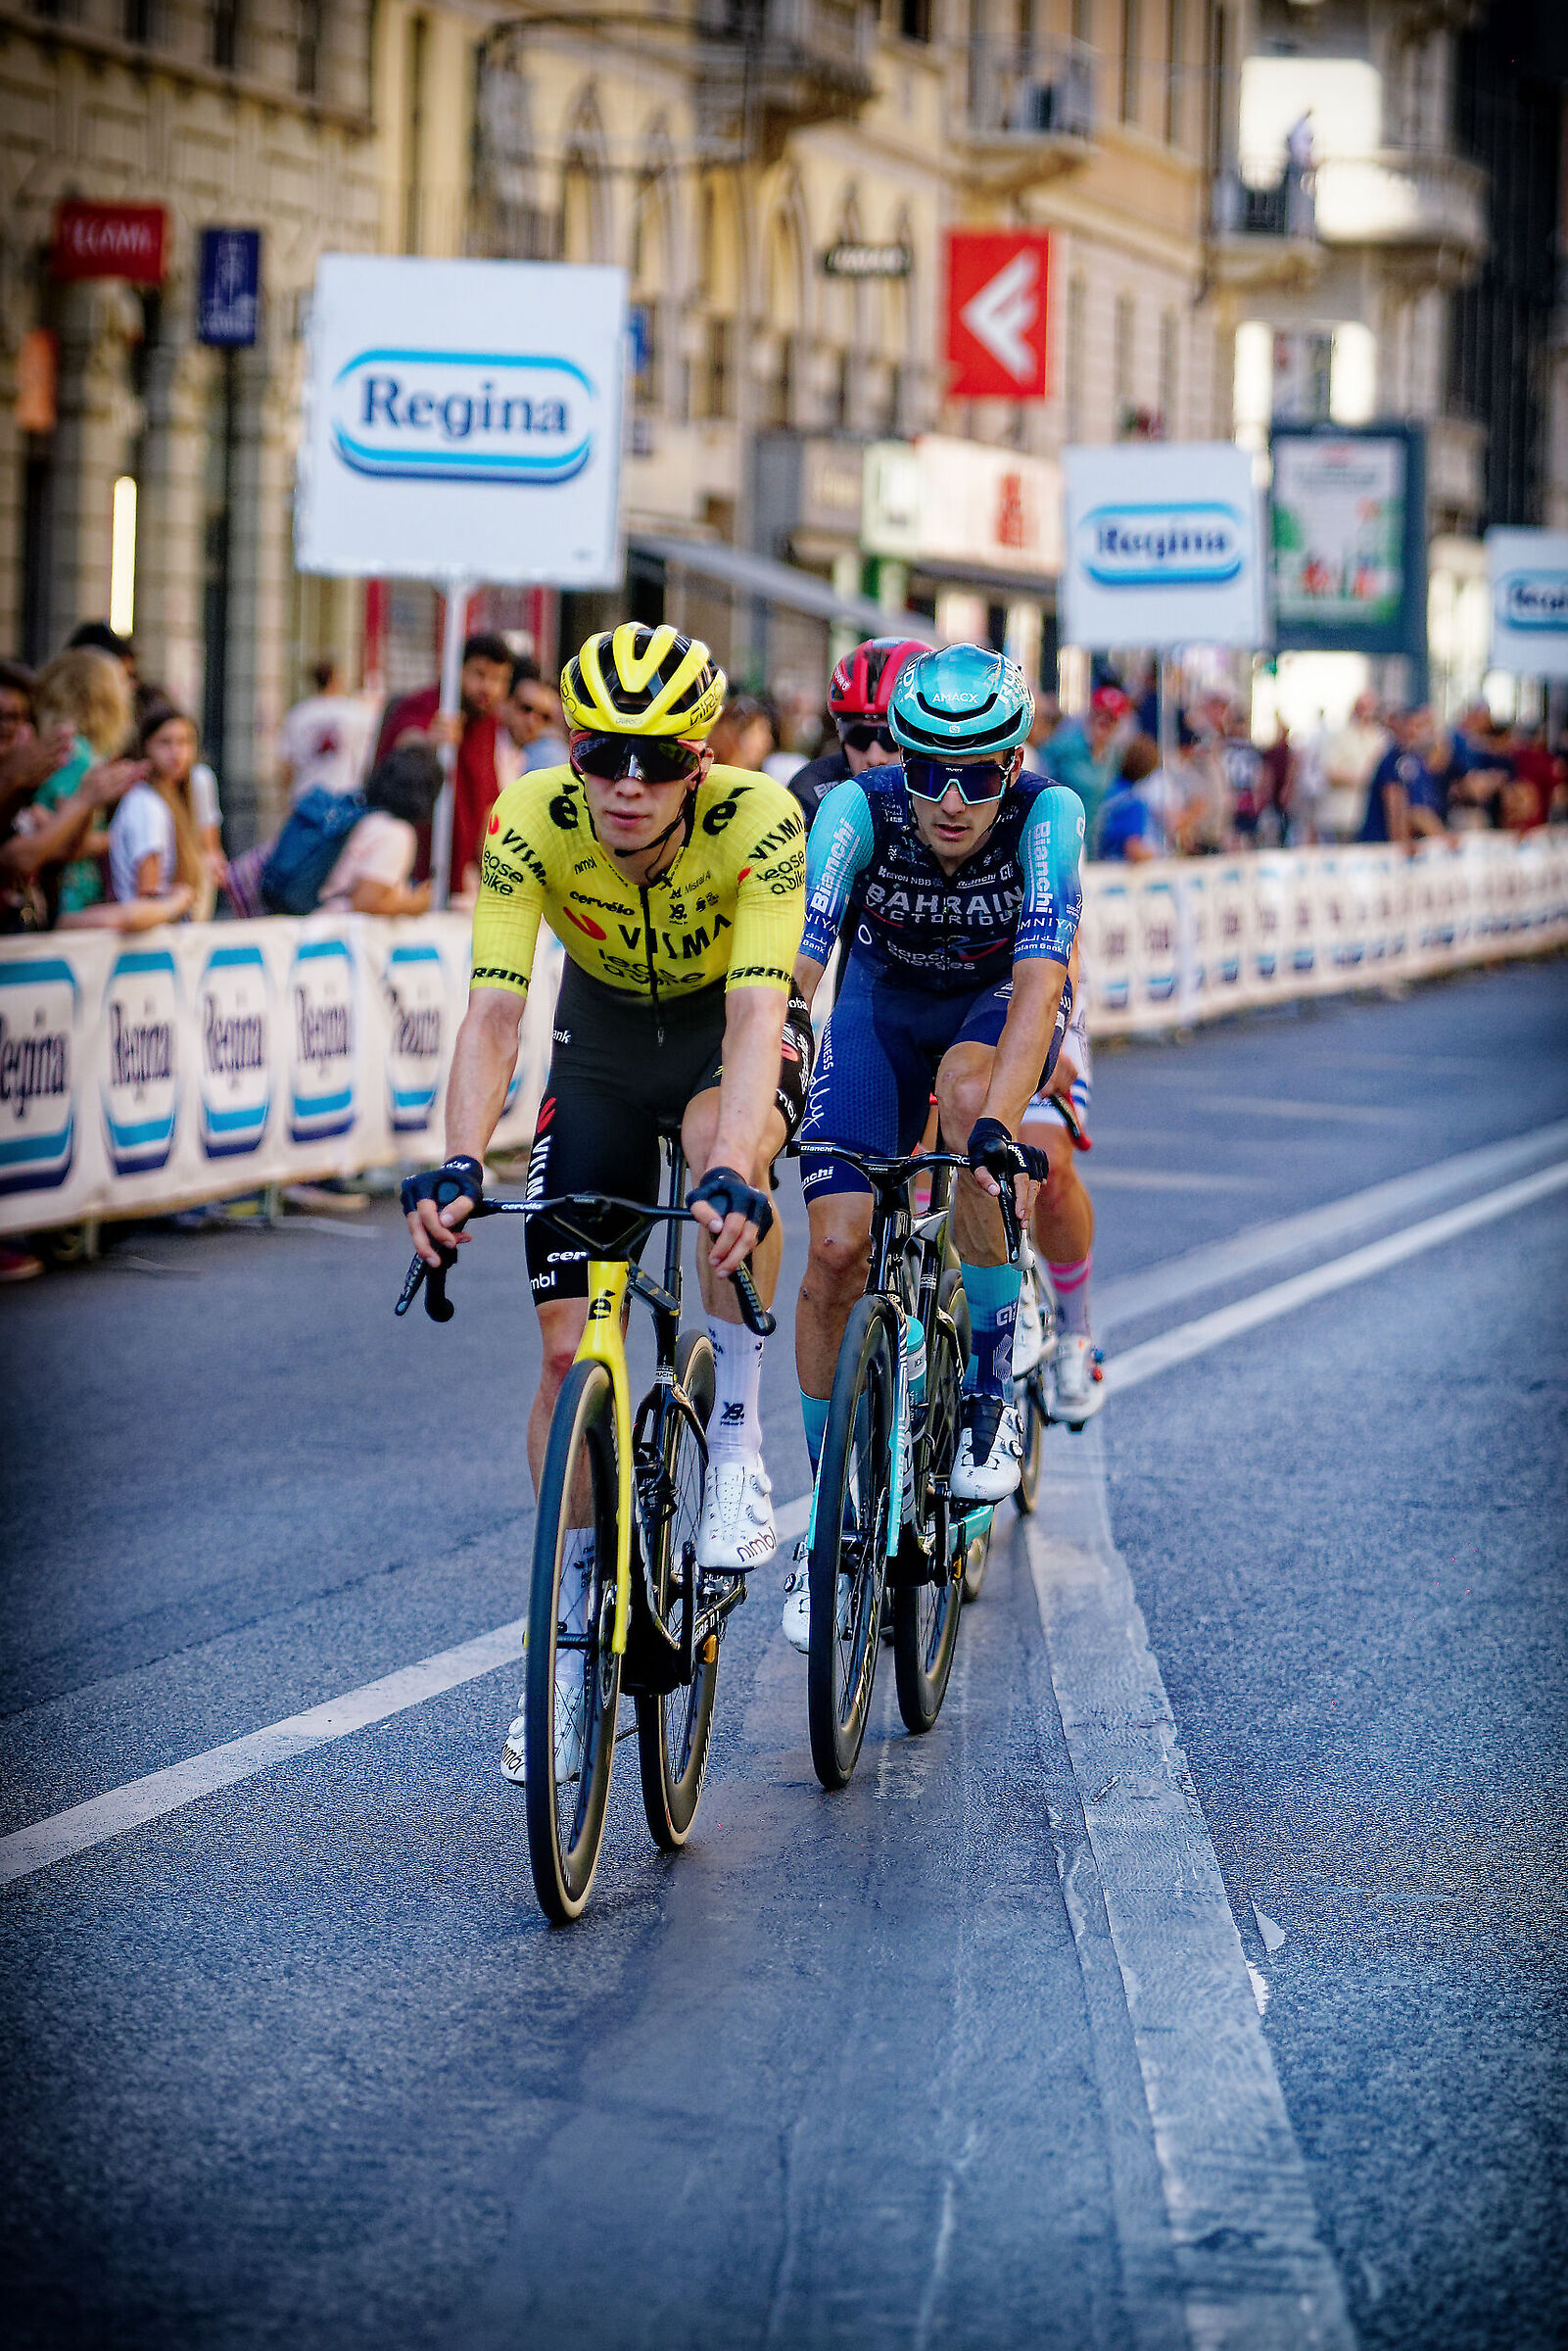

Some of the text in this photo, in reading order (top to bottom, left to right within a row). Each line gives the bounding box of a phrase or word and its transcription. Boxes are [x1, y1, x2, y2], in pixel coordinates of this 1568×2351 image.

[363, 376, 568, 439] Regina
[1097, 525, 1226, 559] Regina
[932, 692, 978, 704] AMACX
[483, 848, 524, 884] ease
[811, 817, 856, 913] Bianchi
[1034, 821, 1053, 913] Bianchi
[569, 890, 635, 916] cervélo
[867, 883, 1024, 915] BAHRAIN
[618, 913, 733, 960] VISMA
[802, 939, 826, 954] Bank
[1039, 943, 1063, 952] Bank
[472, 967, 529, 990] RAM
[786, 996, 809, 1010] oba
[204, 990, 263, 1091] Regina
[295, 984, 350, 1079] Regina
[552, 1030, 571, 1044] ank
[110, 996, 172, 1105] Regina
[802, 1167, 834, 1185] nchi
[500, 1202, 543, 1211] cervélo
[530, 1270, 556, 1291] mbl
[736, 1526, 777, 1563] nimbl
